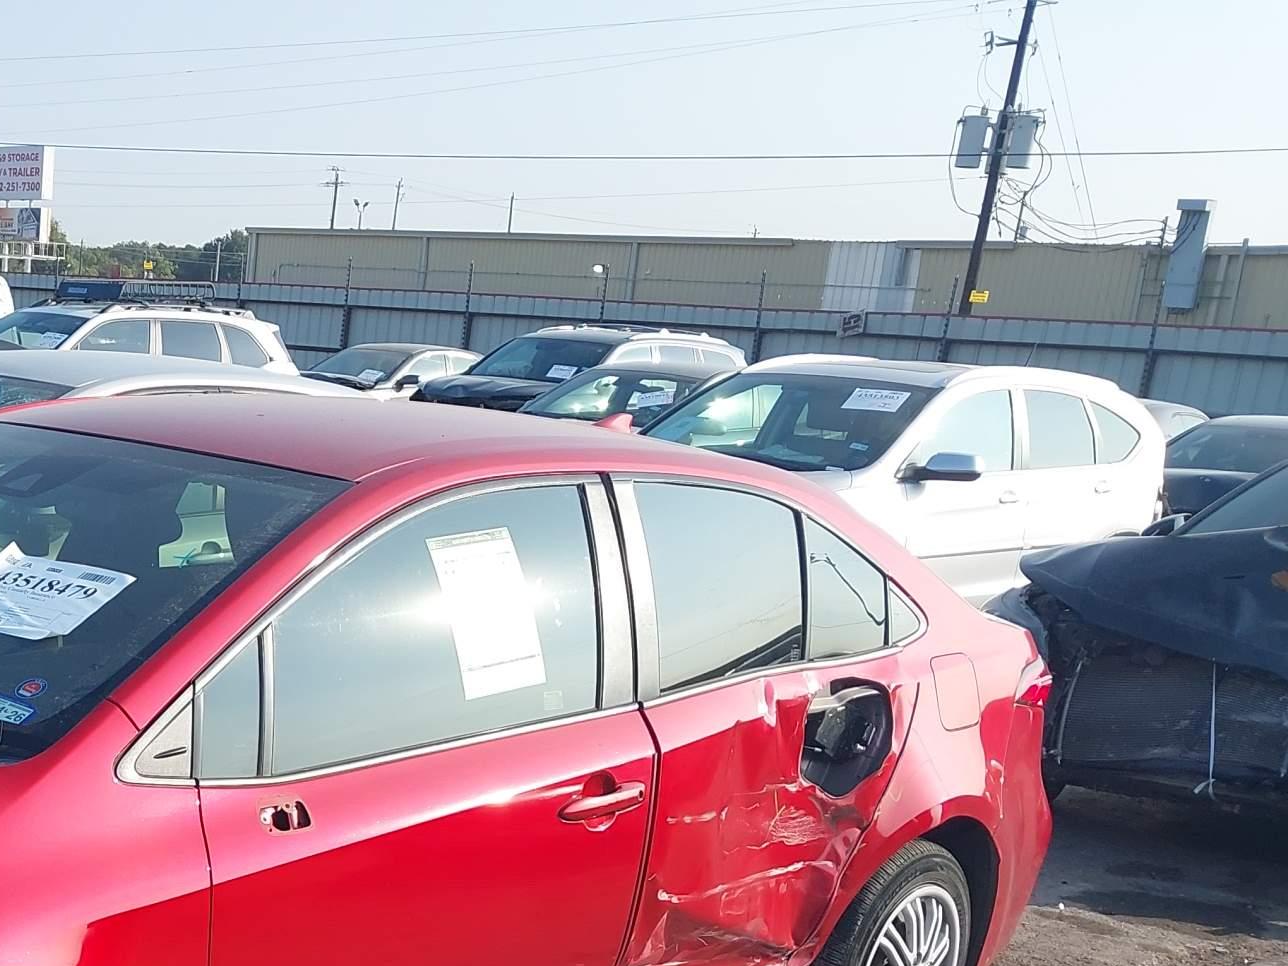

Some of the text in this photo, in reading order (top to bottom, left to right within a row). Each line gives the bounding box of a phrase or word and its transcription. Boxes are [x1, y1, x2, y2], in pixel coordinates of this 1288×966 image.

[7, 152, 40, 162] STORAGE
[8, 166, 40, 177] TRAILER
[5, 710, 26, 722] 26
